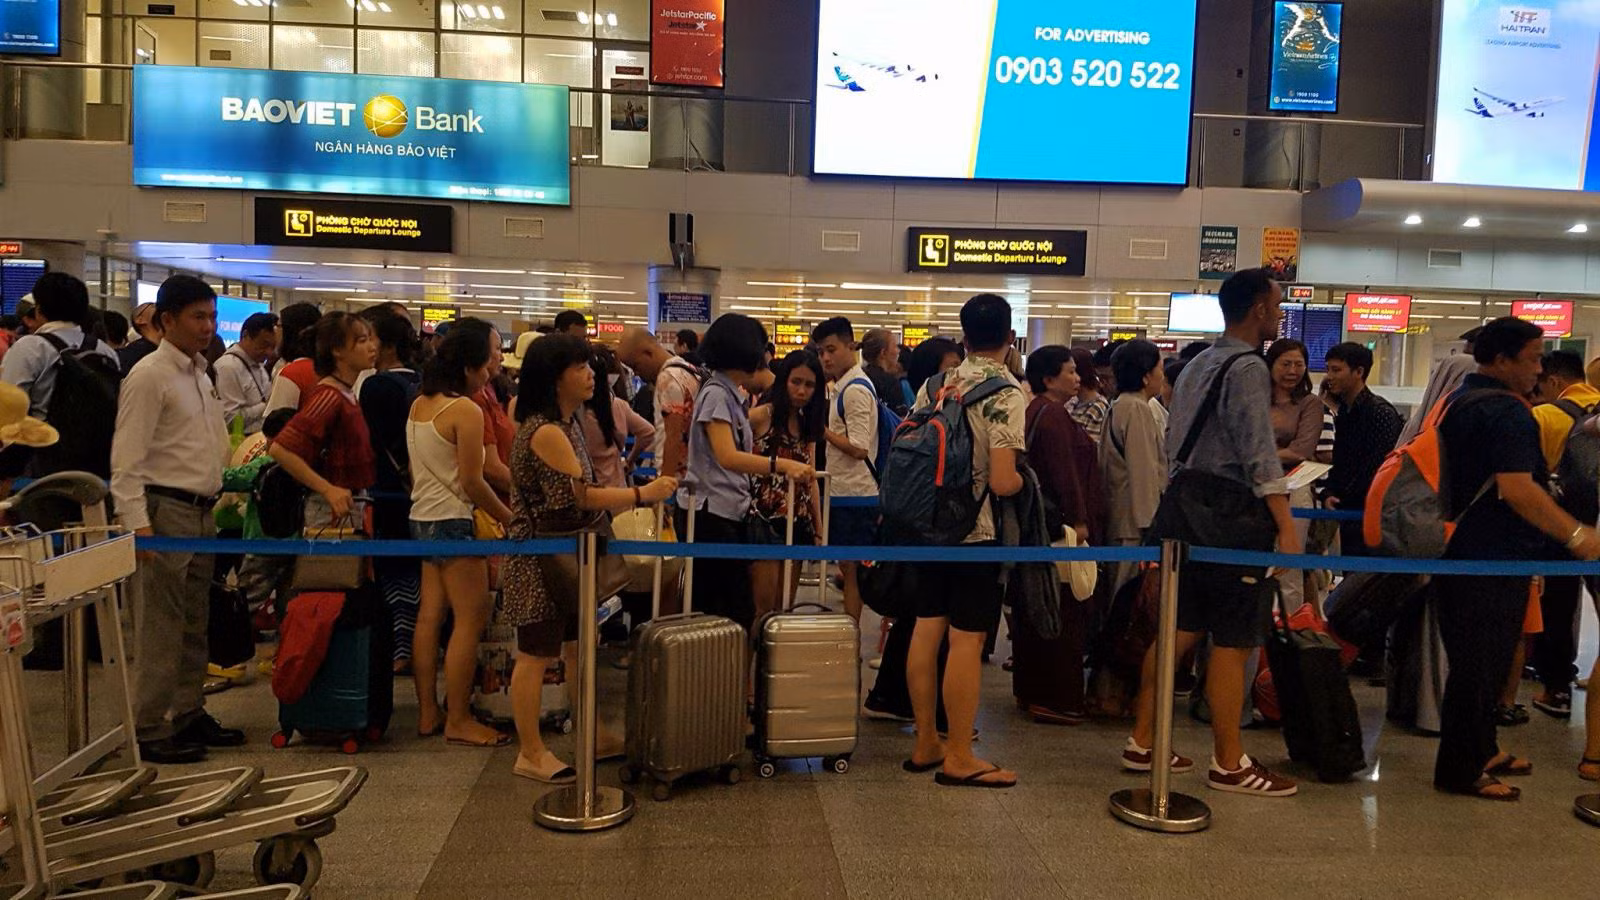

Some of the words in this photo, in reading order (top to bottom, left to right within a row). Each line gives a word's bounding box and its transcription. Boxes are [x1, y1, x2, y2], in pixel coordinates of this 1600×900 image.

[660, 9, 716, 20] JetstarPacific
[1035, 27, 1061, 41] FOR
[1064, 28, 1151, 45] ADVERTISING
[995, 56, 1063, 85] 0903
[1071, 59, 1122, 87] 520
[1130, 61, 1180, 90] 522
[222, 96, 356, 127] BAOVIET
[416, 106, 484, 134] Bank
[315, 139, 352, 154] NGÂN
[356, 140, 393, 156] HÀNG
[397, 142, 425, 157] BẢO
[427, 144, 457, 160] VIỆT
[316, 215, 349, 227] PHÒNG
[350, 216, 371, 227] CHỜ
[373, 217, 399, 229] QUỐC
[401, 218, 418, 230] NỘI
[316, 225, 352, 235] Domestic
[353, 226, 391, 238] Departure
[392, 228, 421, 238] Lounge
[954, 239, 986, 250] PHÒNG
[987, 239, 1008, 251] CHỜ
[1009, 240, 1035, 251] QUỐC
[1037, 240, 1053, 252] NỘI
[954, 252, 992, 262] Domestic
[994, 253, 1034, 264] Departure
[1036, 254, 1067, 264] Lounge
[604, 324, 624, 333] FOOD
